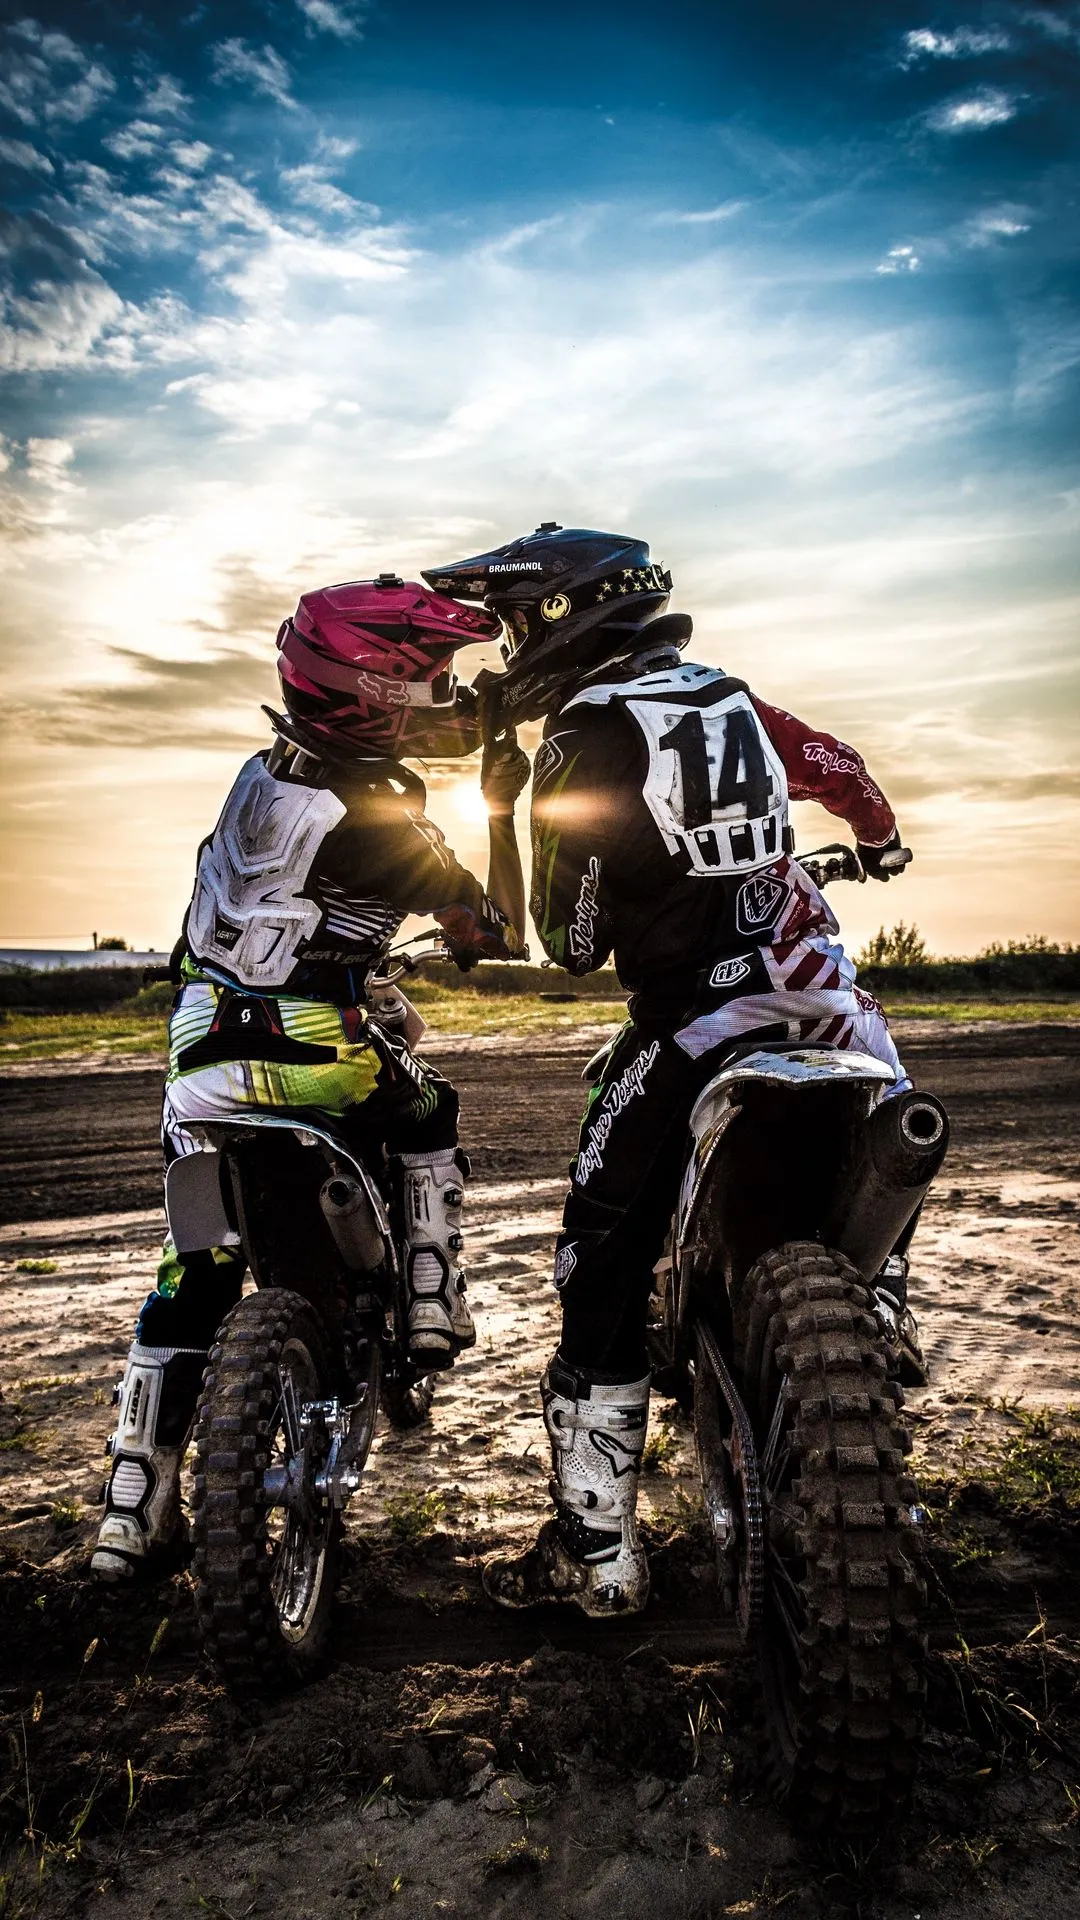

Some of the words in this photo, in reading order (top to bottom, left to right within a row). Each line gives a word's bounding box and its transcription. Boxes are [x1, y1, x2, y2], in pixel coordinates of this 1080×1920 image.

[488, 561, 543, 573] BRAUMANDL
[658, 710, 774, 831] 14
[803, 742, 833, 775] Troy
[829, 752, 858, 774] Lee
[569, 856, 599, 956] Designs
[588, 1112, 613, 1151] Lee
[602, 1040, 661, 1117] Designs
